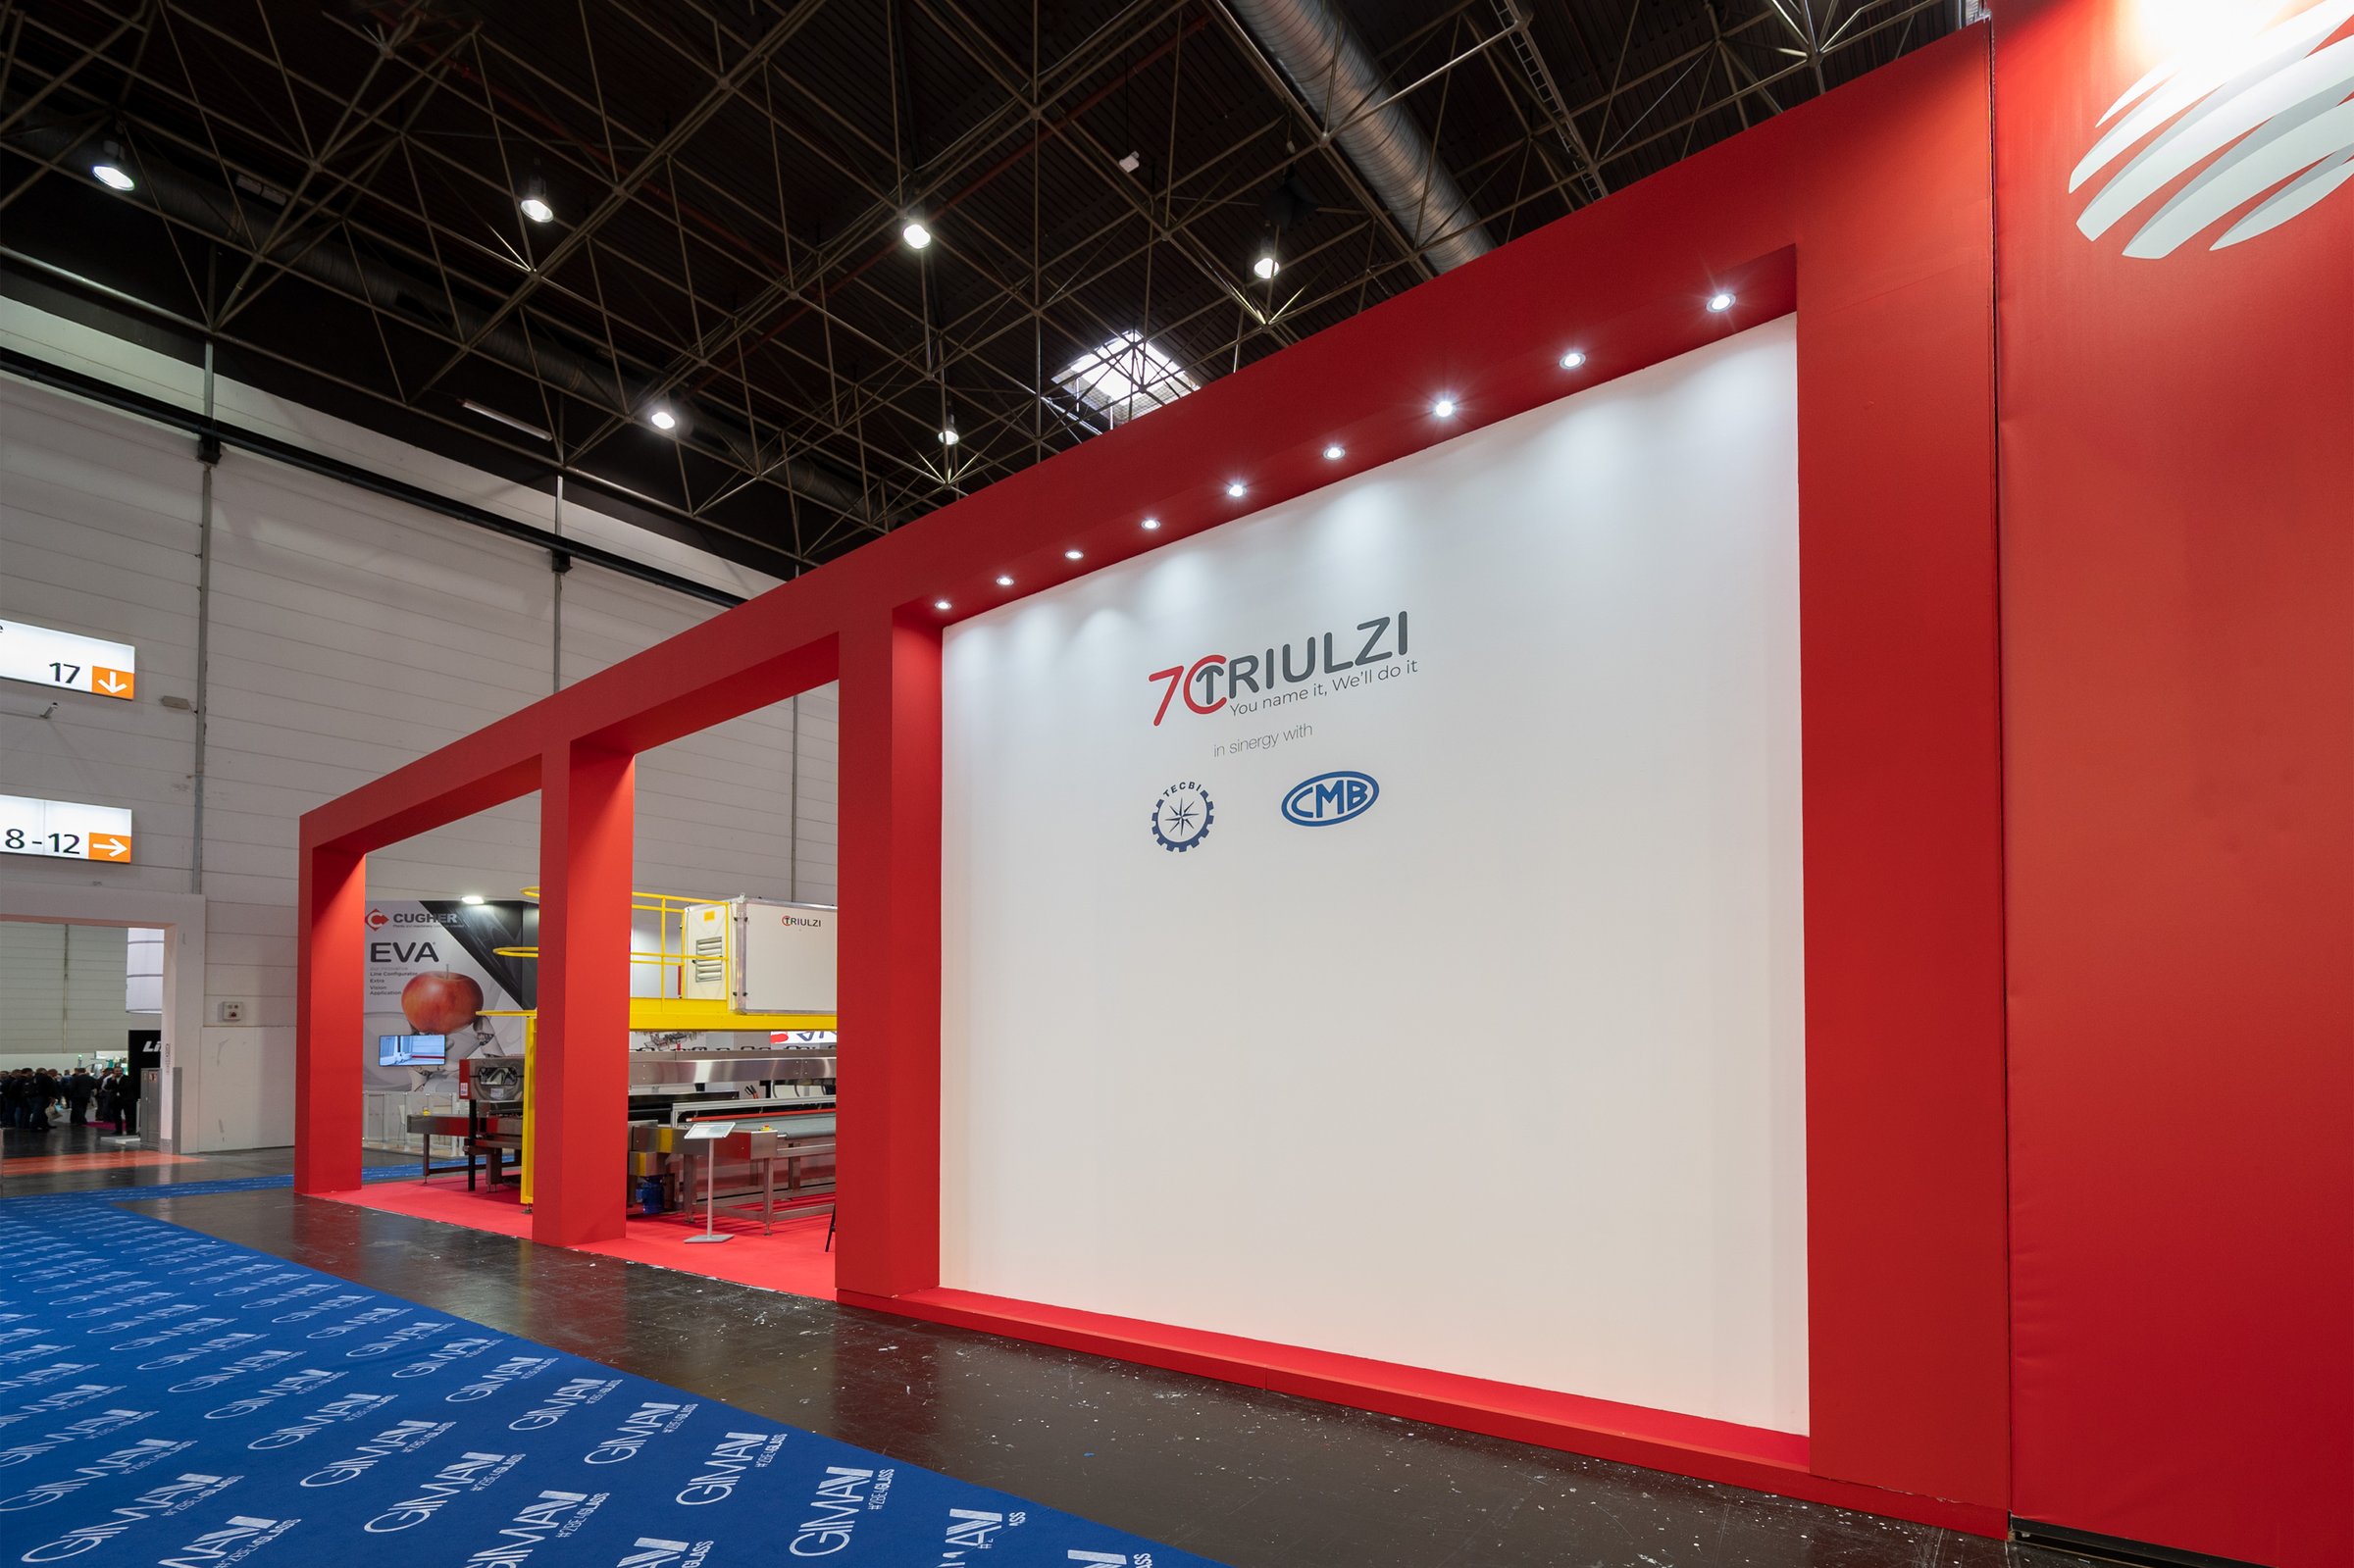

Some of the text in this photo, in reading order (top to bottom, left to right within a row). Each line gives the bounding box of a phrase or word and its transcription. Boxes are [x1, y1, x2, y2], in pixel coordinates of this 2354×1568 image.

[1196, 611, 1407, 705] TRIULZI
[49, 662, 80, 684] 17
[1230, 659, 1418, 717] You name it, We'll do it
[1213, 723, 1313, 758] in sinergy with
[1162, 781, 1203, 798] TECBI
[1291, 780, 1368, 818] CMB
[393, 913, 458, 924] CUGHER
[782, 916, 822, 928] TRIULZI
[370, 941, 439, 963] EVA
[142, 1040, 162, 1052] Li
